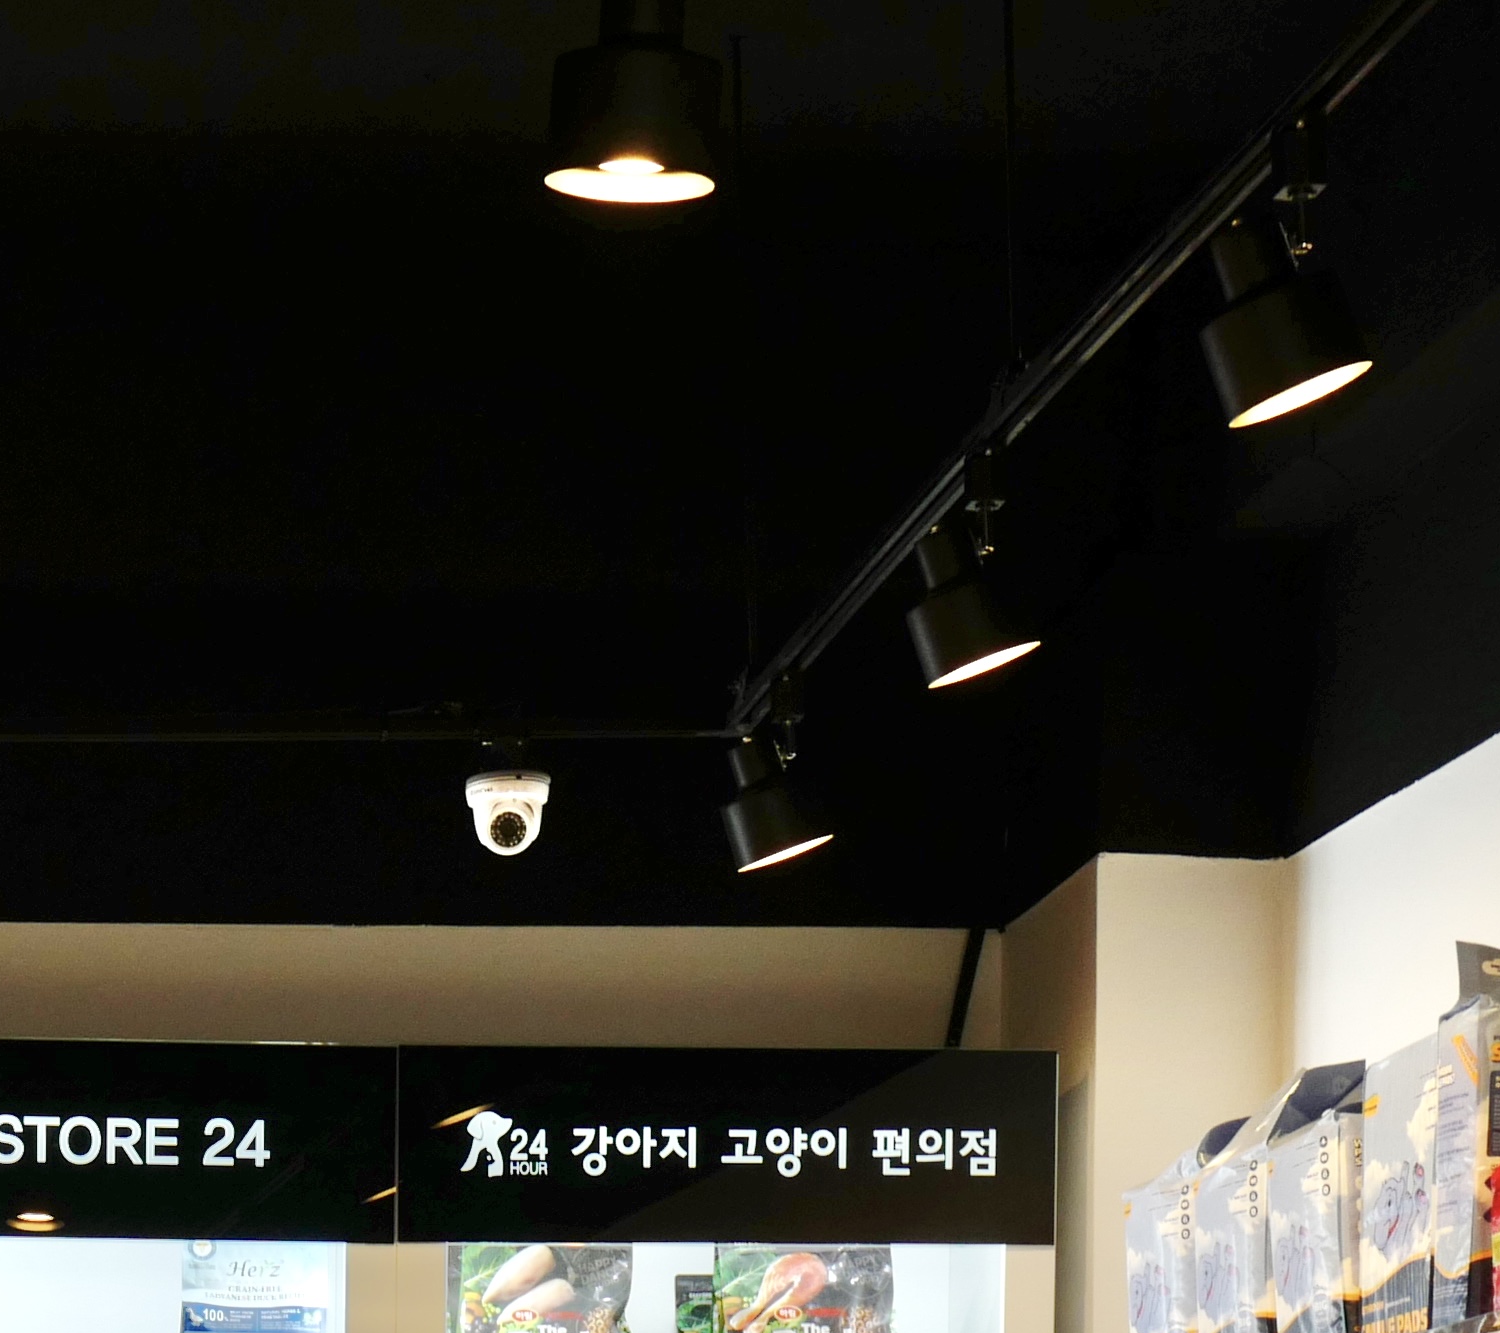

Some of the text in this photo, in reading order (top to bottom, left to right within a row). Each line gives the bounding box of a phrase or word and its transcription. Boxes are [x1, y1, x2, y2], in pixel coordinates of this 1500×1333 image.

[203, 1118, 270, 1167] 24
[510, 1126, 997, 1177] 24 강아지 고양이 편의점
[510, 1162, 548, 1176] HOUR
